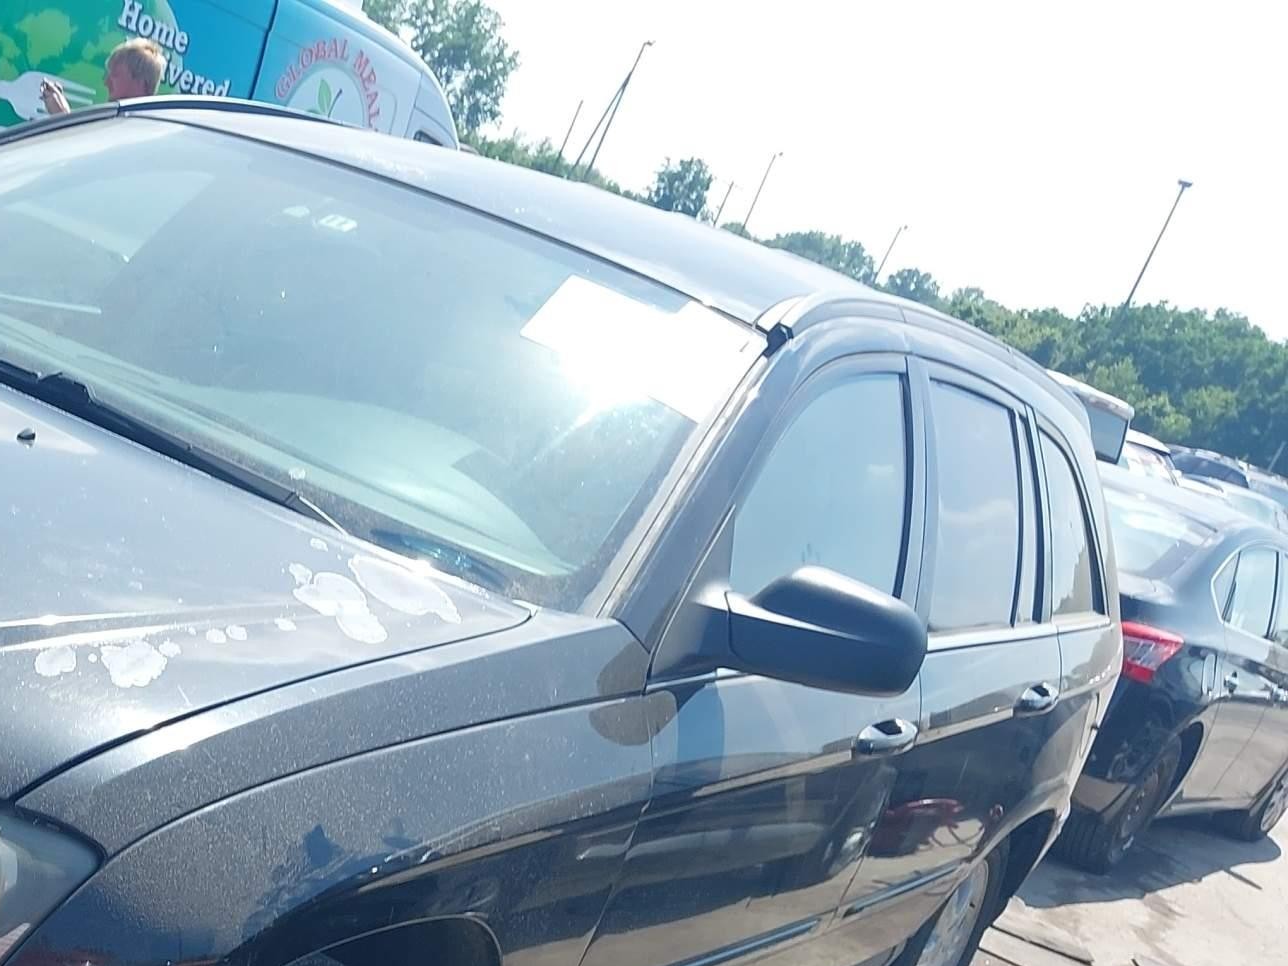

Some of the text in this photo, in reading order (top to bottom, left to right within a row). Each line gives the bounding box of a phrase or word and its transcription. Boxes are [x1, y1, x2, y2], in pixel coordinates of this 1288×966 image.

[118, 0, 189, 53] Home
[159, 52, 231, 97] ivered
[274, 37, 380, 132] GLOBAL MEAL
